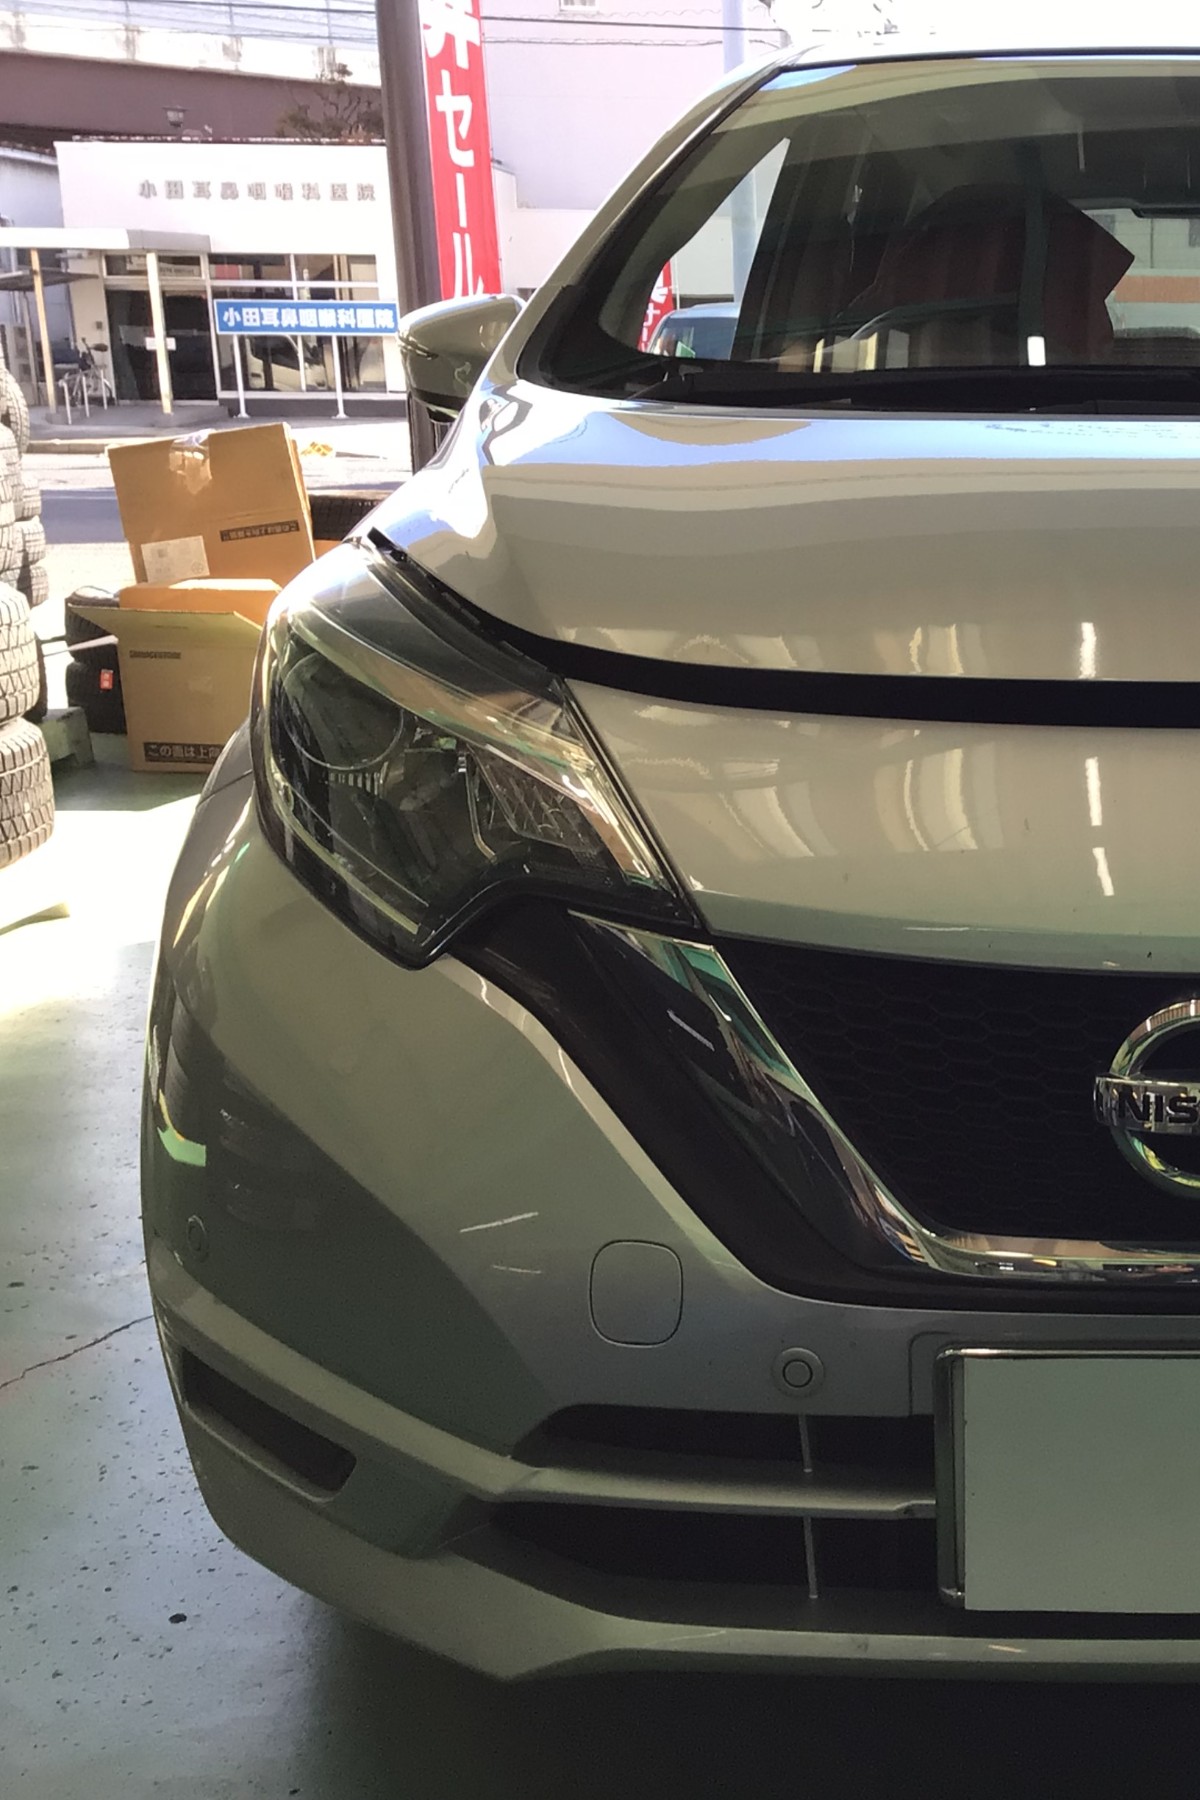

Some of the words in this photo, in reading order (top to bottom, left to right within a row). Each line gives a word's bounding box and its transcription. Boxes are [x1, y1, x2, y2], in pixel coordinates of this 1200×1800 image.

[139, 179, 376, 201] 小田耳鼻咽喉科医院
[222, 306, 395, 329] 小田耳鼻咽喉科医院
